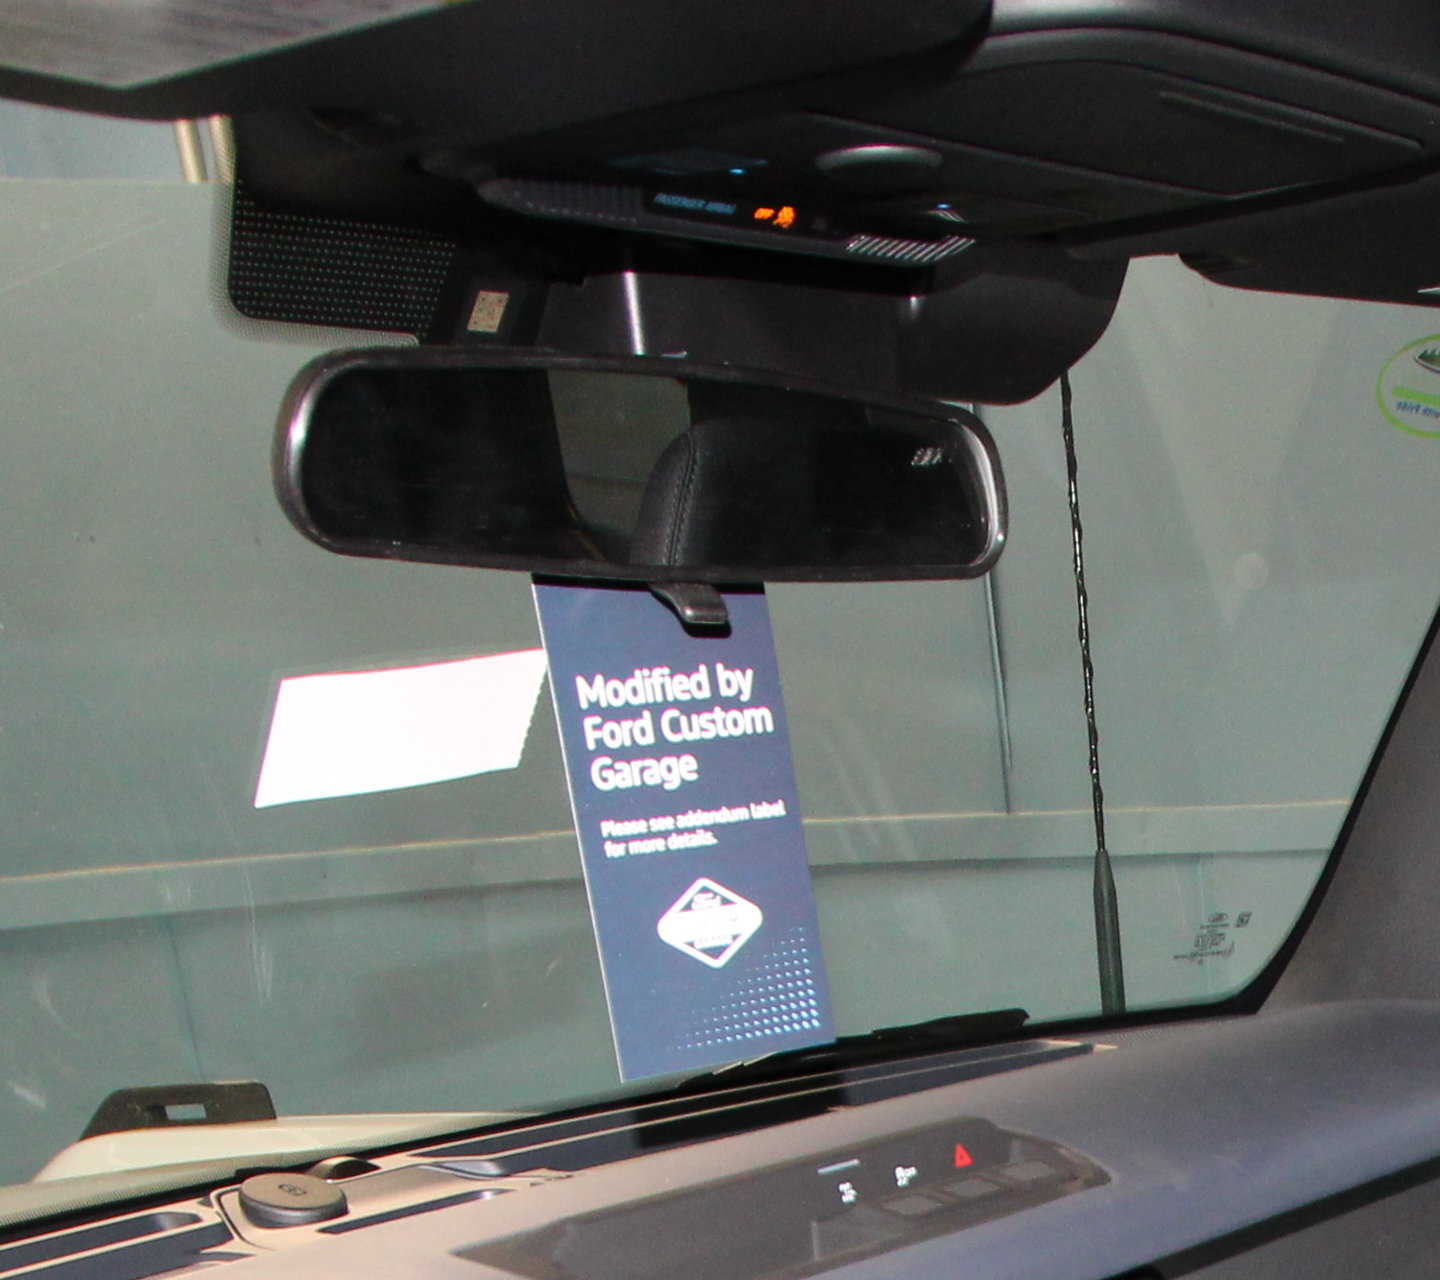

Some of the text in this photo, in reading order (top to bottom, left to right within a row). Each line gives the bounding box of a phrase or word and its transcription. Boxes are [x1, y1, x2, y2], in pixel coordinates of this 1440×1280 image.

[574, 662, 754, 710] Modified by
[583, 706, 775, 750] Ford Custom
[590, 753, 699, 791] Garage
[600, 799, 788, 838] Please see addendum label
[604, 840, 626, 859] for
[628, 836, 666, 856] more
